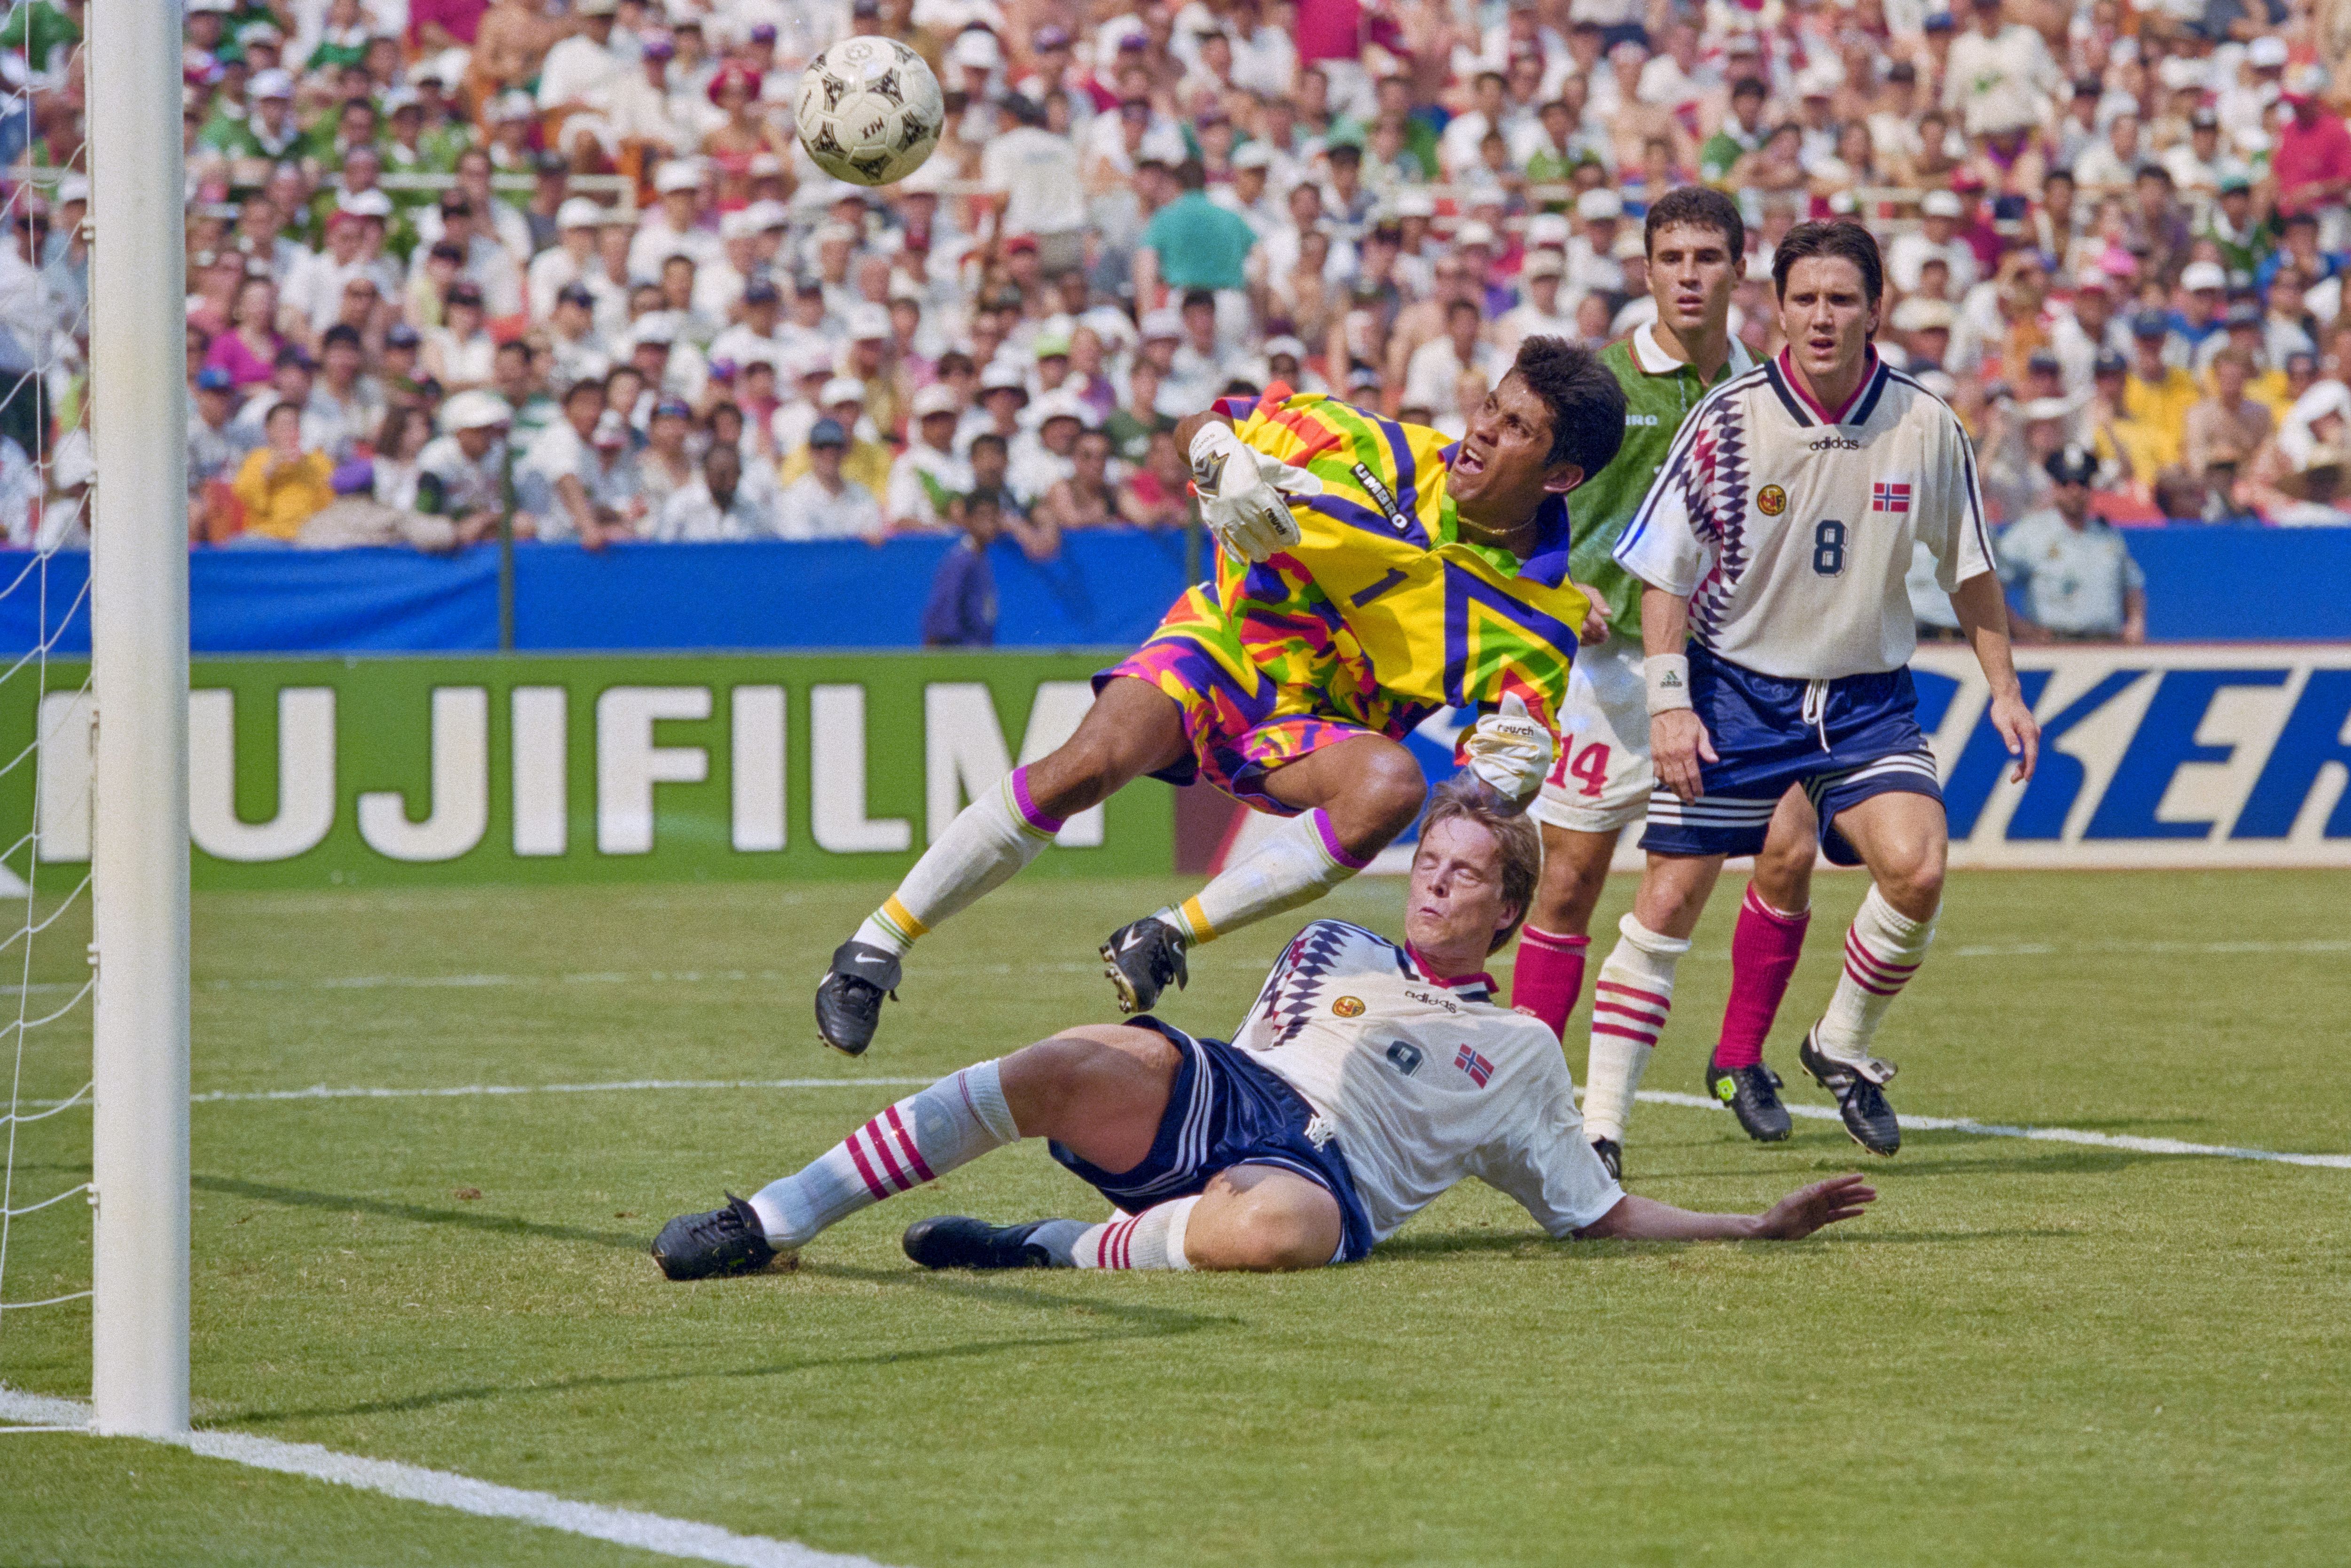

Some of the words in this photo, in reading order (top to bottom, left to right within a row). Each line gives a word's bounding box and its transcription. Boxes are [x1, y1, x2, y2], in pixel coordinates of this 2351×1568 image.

[1809, 436, 1859, 451] adidas
[1354, 463, 1408, 529] UMBRO
[1813, 520, 1849, 578] 8
[1350, 567, 1409, 608] 1
[1545, 733, 1611, 798] 14
